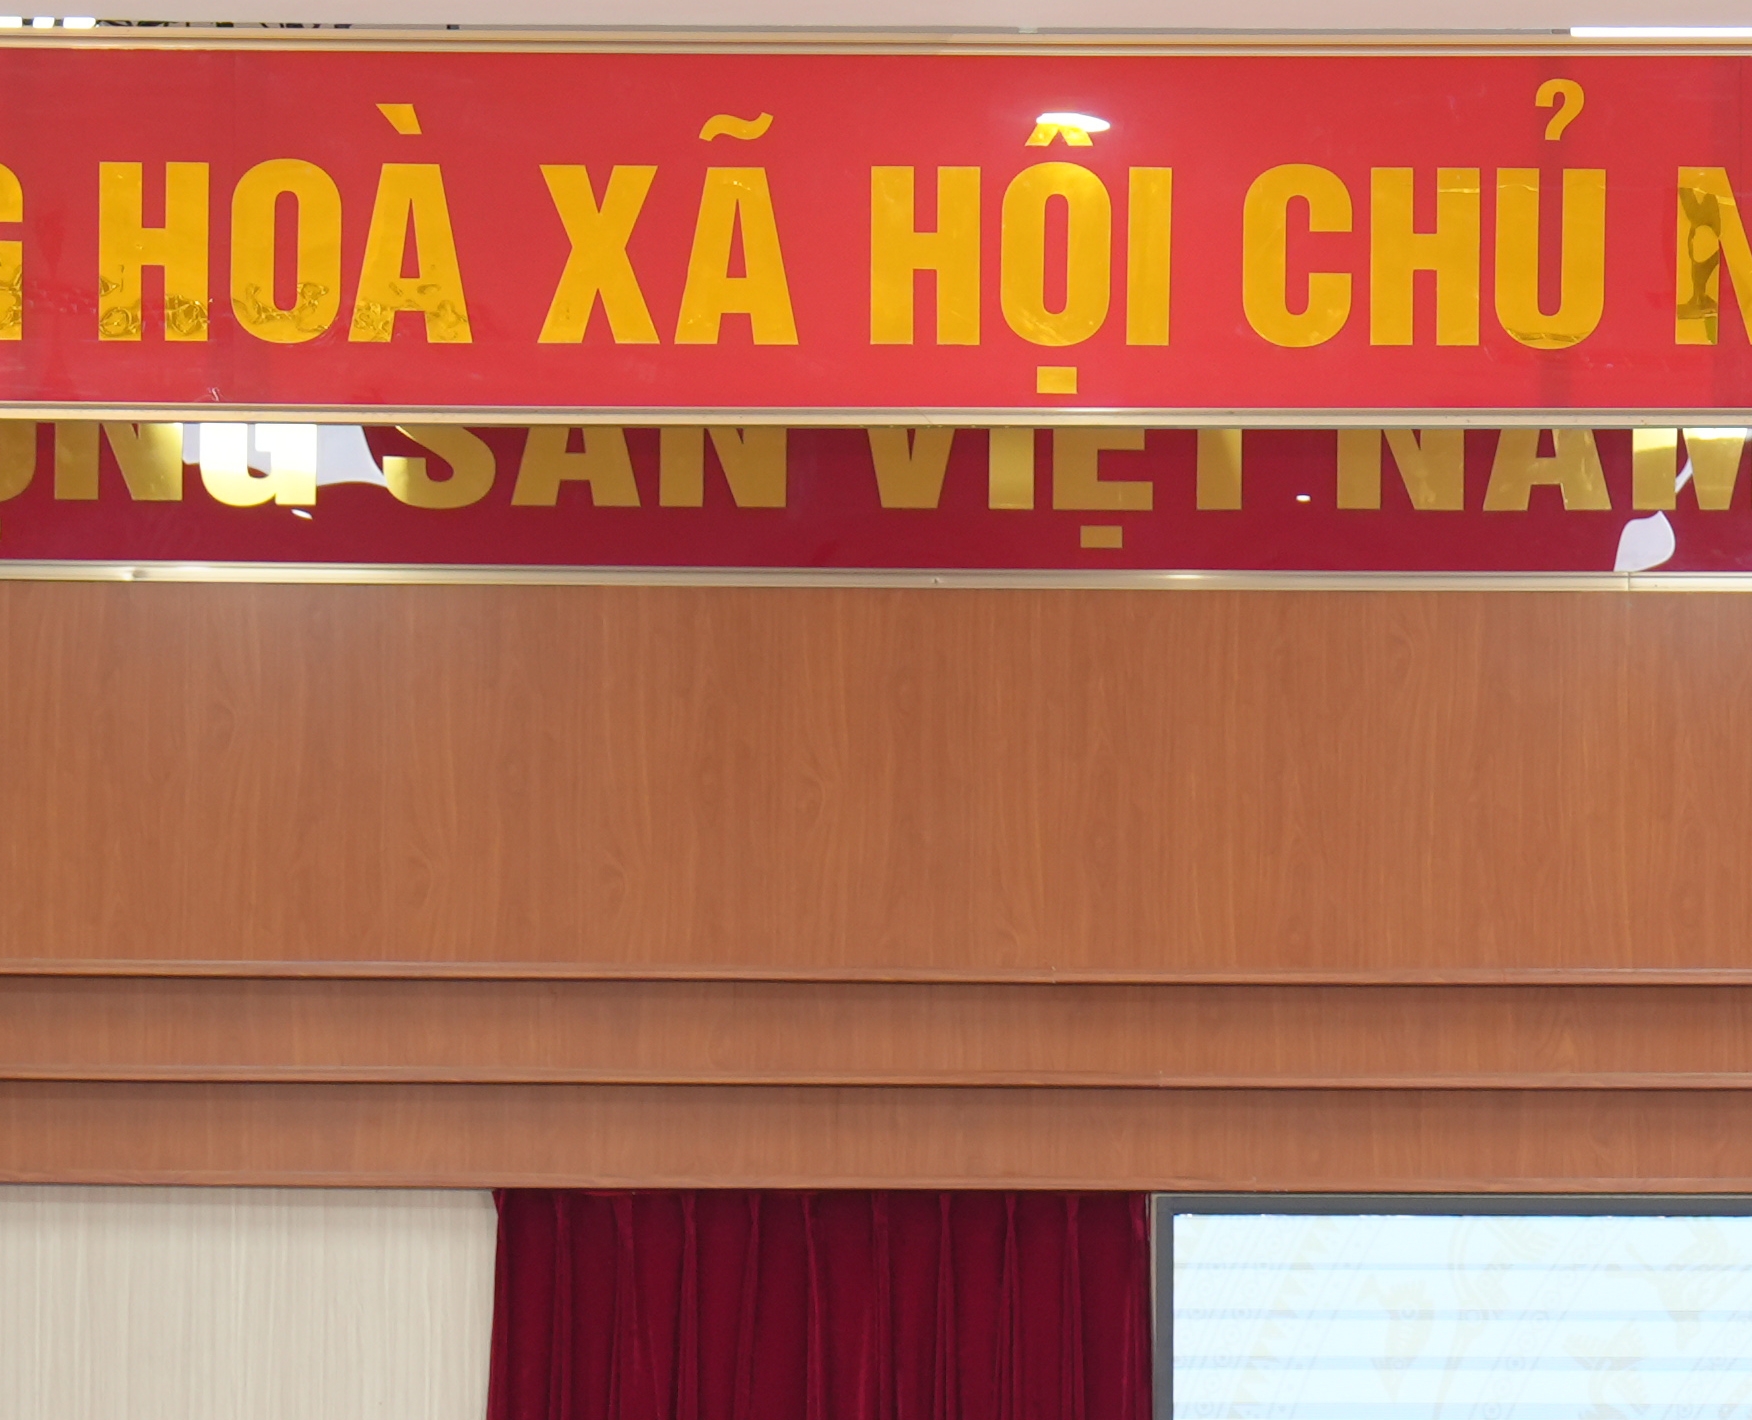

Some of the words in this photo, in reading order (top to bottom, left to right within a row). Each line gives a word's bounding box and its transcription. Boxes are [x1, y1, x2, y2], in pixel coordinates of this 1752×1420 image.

[97, 104, 471, 344] HOÀ
[538, 113, 799, 345] XÃ
[869, 113, 1171, 394] HỘI
[1242, 79, 1605, 349] CHỦ
